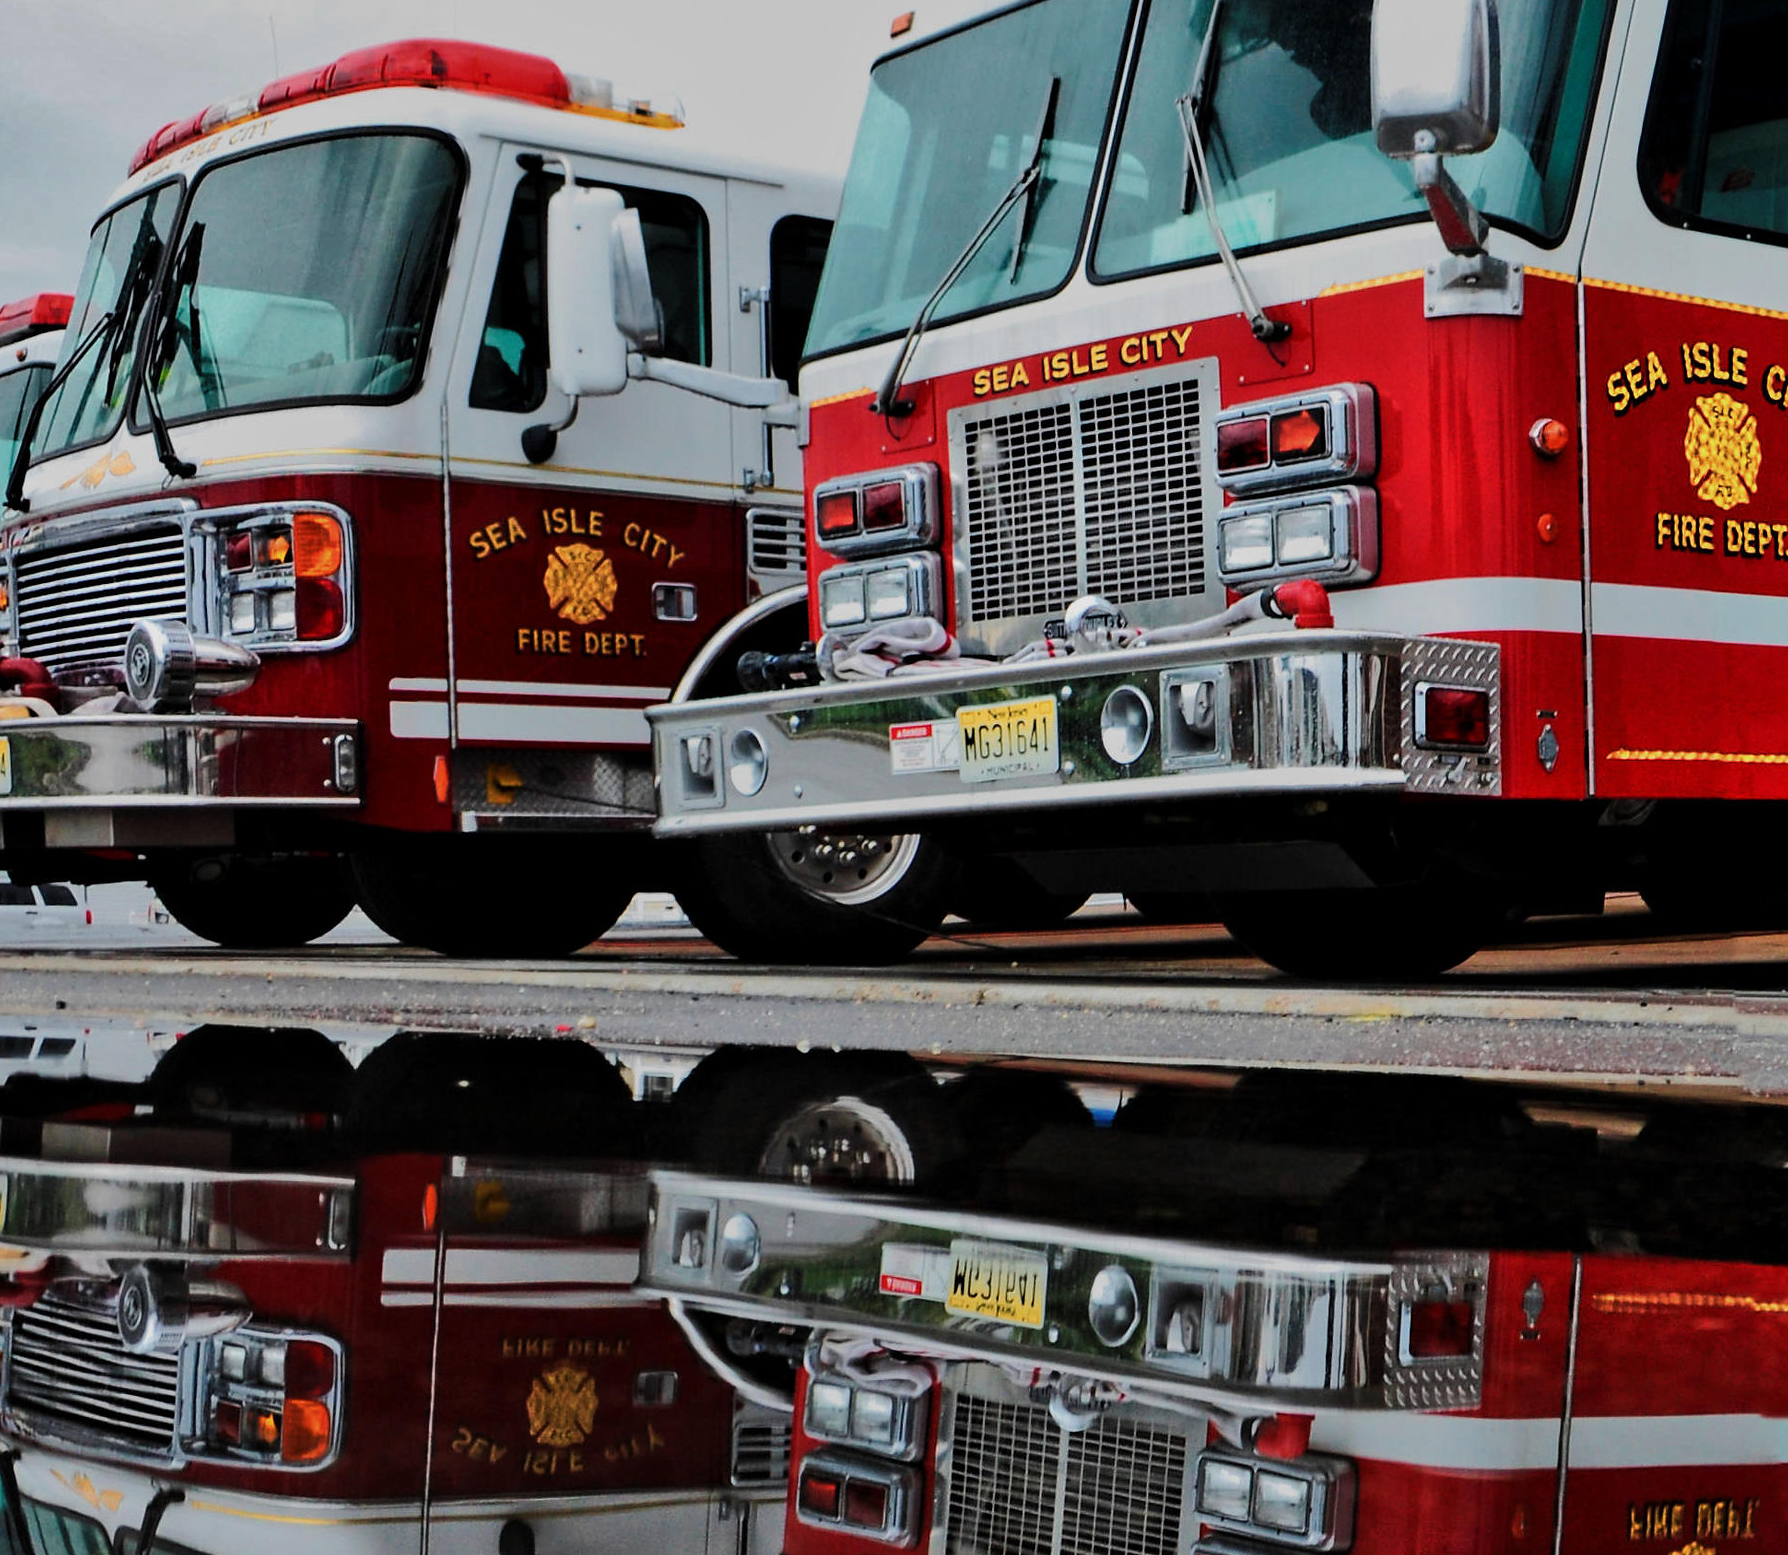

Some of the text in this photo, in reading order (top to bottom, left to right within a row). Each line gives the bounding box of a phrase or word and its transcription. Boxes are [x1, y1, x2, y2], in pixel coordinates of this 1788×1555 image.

[973, 326, 1193, 396] SEA ISLE CITY
[1607, 351, 1669, 414] SEA
[1682, 341, 1749, 387] ISLE
[469, 506, 685, 569] SEA ISLE CITY
[1656, 512, 1715, 551] FIRE
[517, 628, 648, 657] FIRE DEPT.
[964, 716, 1049, 762] MG31641
[985, 762, 1035, 776] MUNICIPAL
